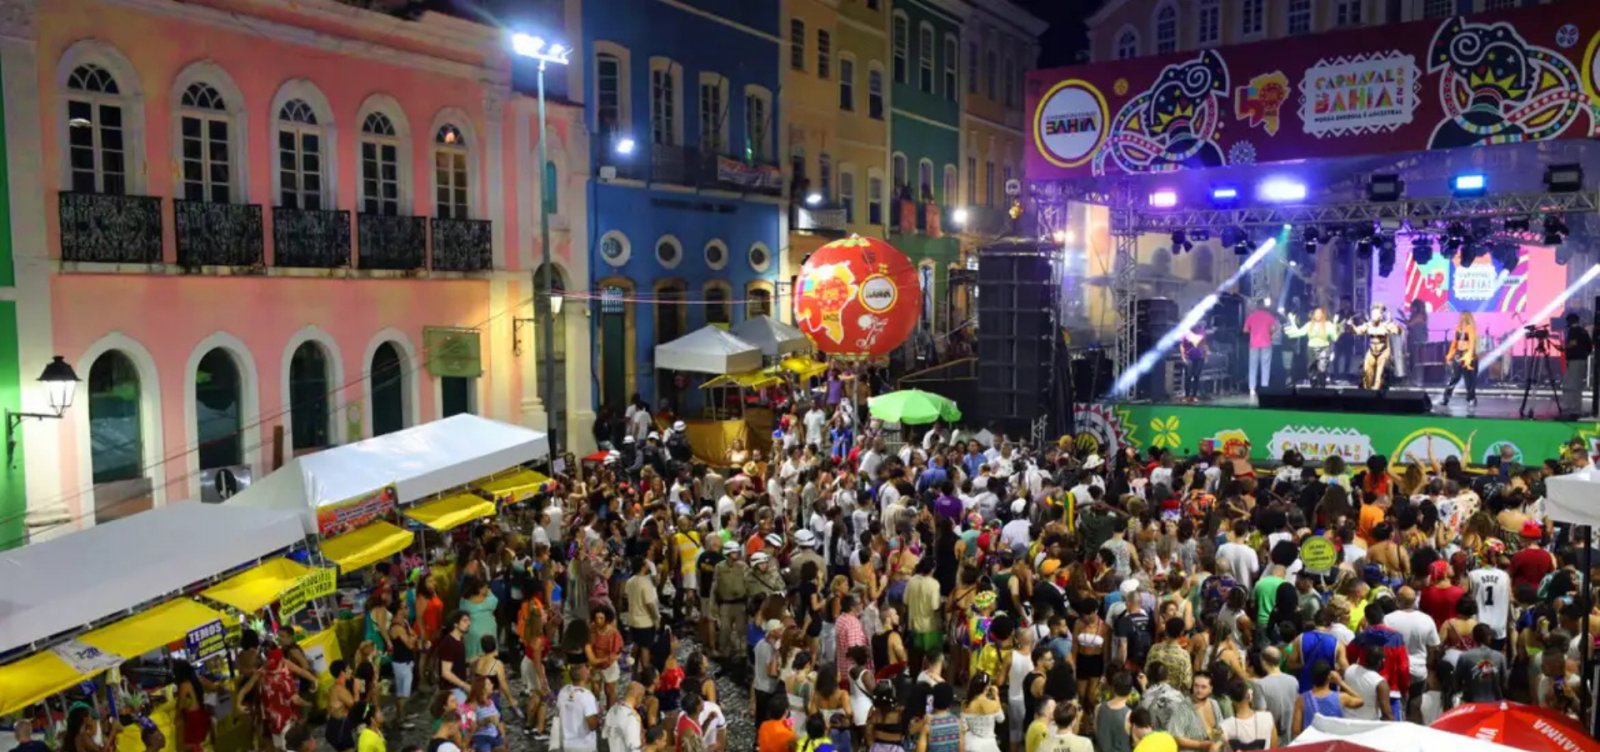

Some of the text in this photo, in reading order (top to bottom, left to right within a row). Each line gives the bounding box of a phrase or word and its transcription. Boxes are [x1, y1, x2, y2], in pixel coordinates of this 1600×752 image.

[1315, 69, 1395, 91] CARNAVAL
[1315, 86, 1393, 114] BAHIA
[1046, 116, 1097, 135] BAHIA
[1282, 441, 1352, 457] CARNAVAL
[1485, 586, 1494, 606] 1
[189, 621, 222, 644] TEMOS
[1532, 718, 1587, 752] AHMA
